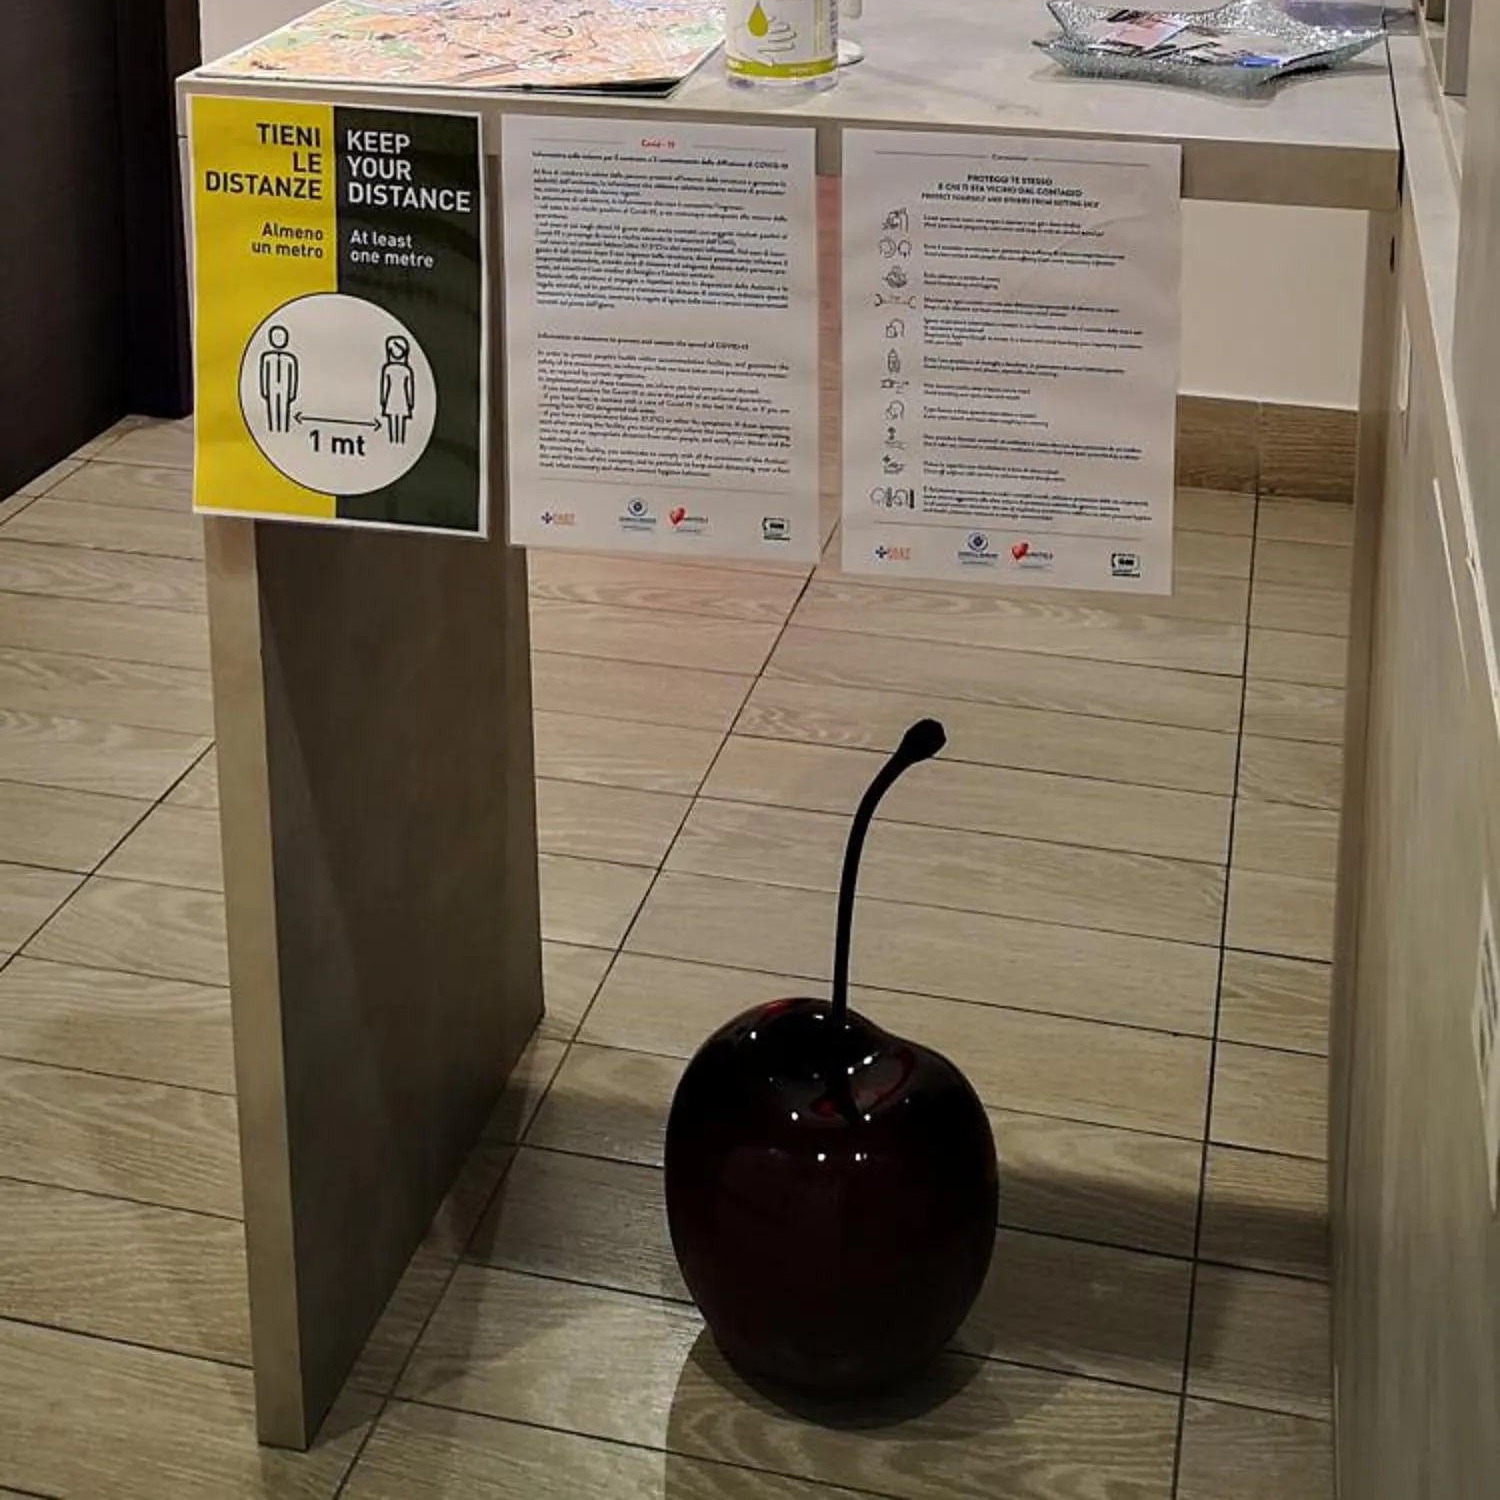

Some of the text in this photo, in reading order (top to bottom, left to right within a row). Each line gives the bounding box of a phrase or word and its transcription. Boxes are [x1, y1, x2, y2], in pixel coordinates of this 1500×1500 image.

[256, 122, 321, 149] TIENI
[346, 128, 411, 155] KEEP
[292, 151, 322, 174] LE
[346, 155, 412, 181] YOUR
[205, 170, 323, 200] DISTANZE
[348, 181, 472, 213] DISTANCE
[261, 221, 324, 241] Almeno
[350, 229, 413, 249] At least
[251, 241, 323, 259] un metro
[350, 249, 434, 268] one metre
[309, 429, 366, 457] 1 mt
